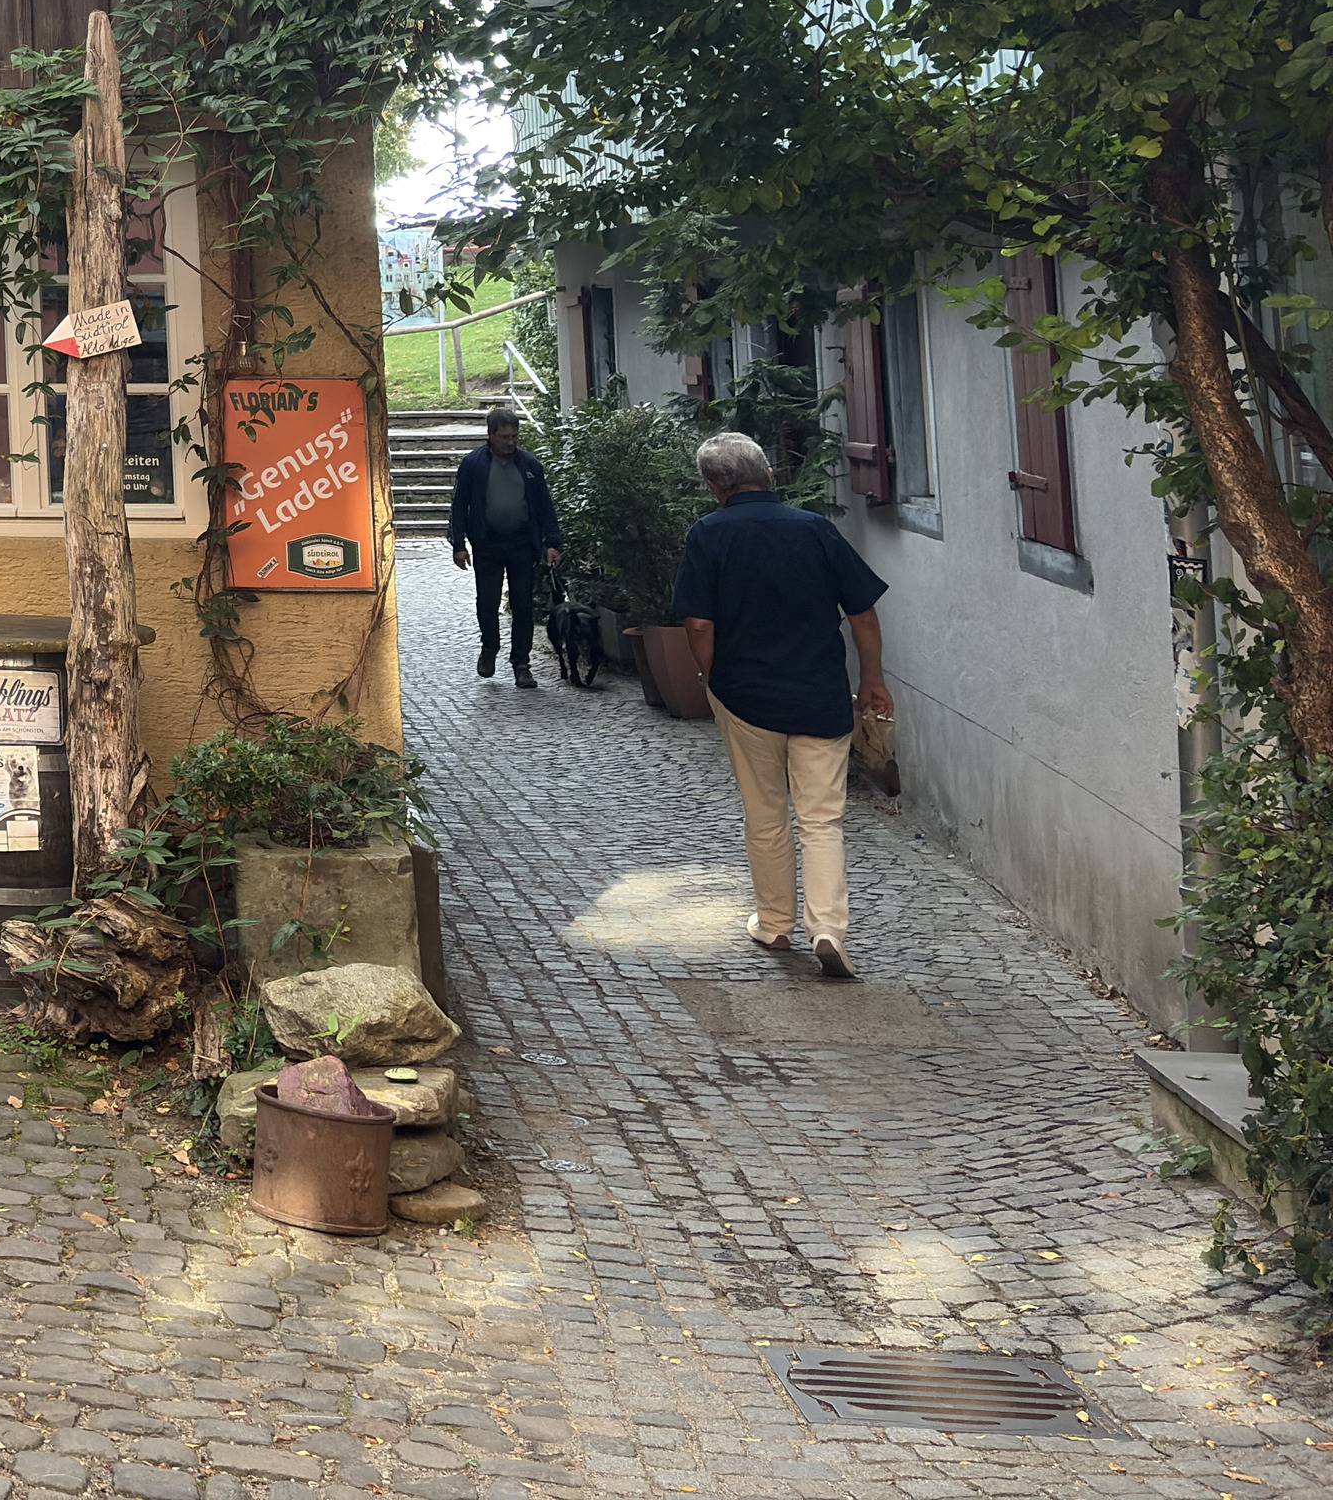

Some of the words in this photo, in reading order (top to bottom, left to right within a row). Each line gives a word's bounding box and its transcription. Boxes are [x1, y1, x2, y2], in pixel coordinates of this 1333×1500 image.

[73, 308, 111, 329] Made
[116, 306, 130, 316] in
[75, 315, 129, 342] Südtirol
[81, 341, 105, 356] Alto
[109, 335, 135, 349] Adige
[124, 473, 150, 482] mstag
[256, 461, 359, 534] Ladele
